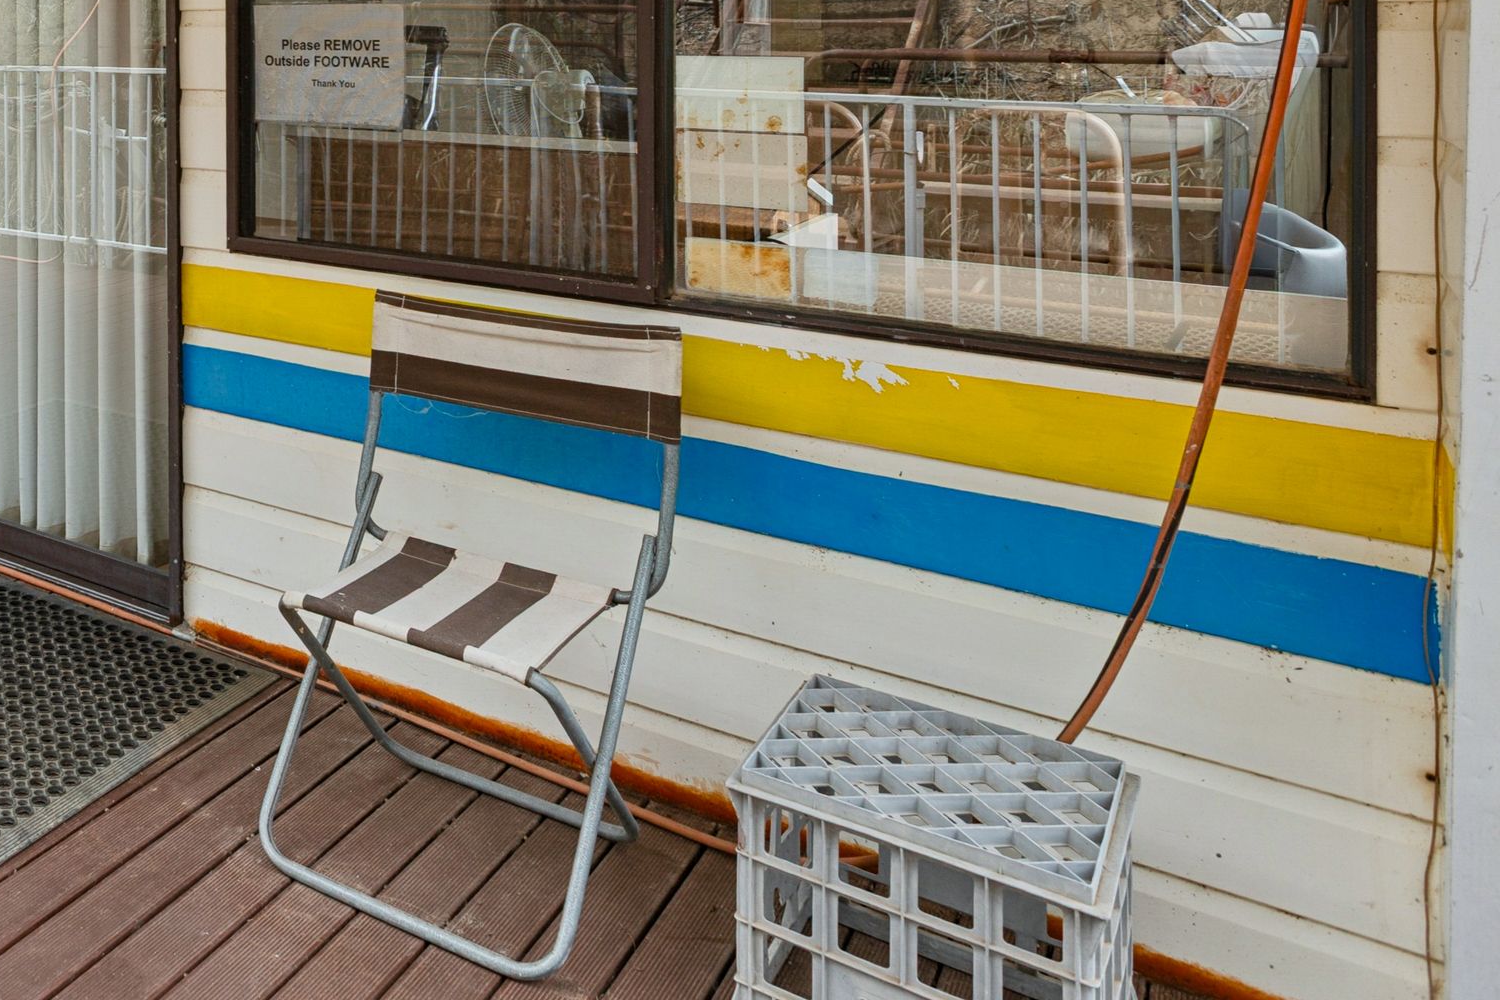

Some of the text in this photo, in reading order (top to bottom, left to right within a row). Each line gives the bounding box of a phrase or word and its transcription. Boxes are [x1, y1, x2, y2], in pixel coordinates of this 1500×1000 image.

[281, 39, 381, 51] Please REMOVE
[264, 54, 390, 69] Outside FOOTWARE
[311, 79, 356, 88] Thank You
